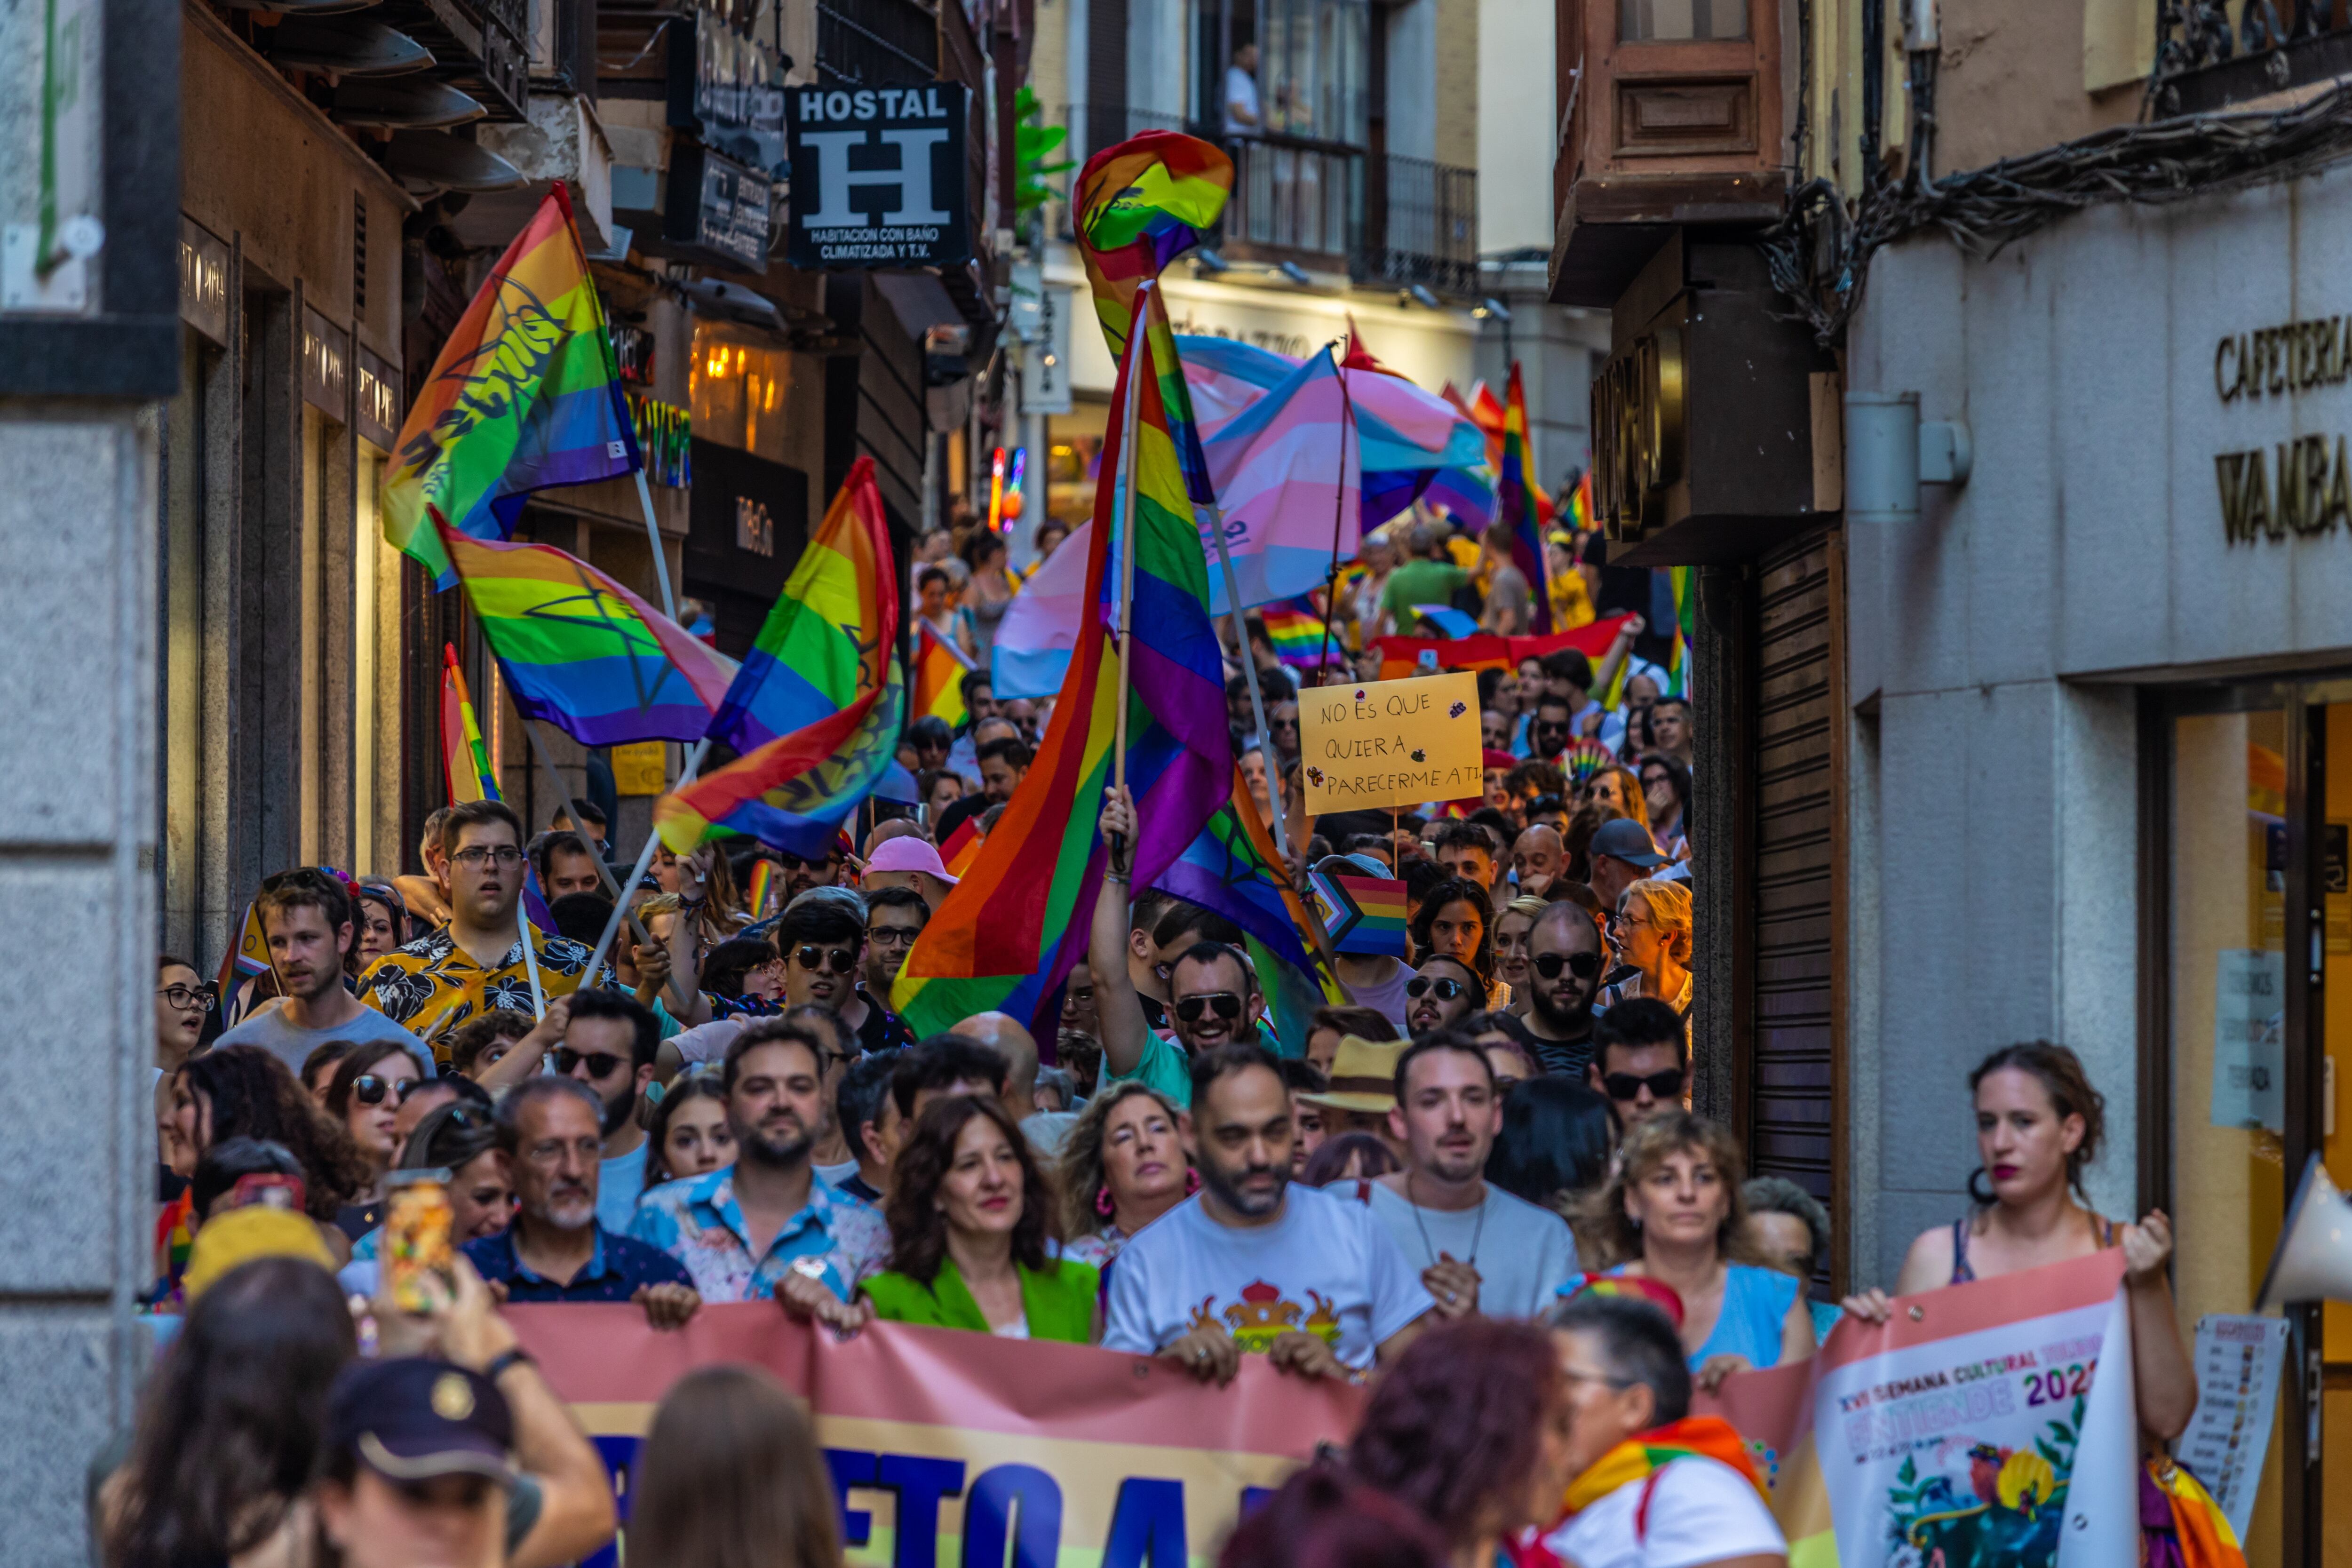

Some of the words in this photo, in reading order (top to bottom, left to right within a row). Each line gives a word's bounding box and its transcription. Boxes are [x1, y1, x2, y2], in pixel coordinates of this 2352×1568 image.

[800, 88, 947, 122] HOSTAL
[801, 129, 950, 228] H
[810, 228, 878, 243] HABITACION
[879, 228, 905, 242] CON
[906, 224, 939, 242] BAÑO
[820, 244, 895, 259] CLIMATIZADA
[897, 243, 906, 258] Y
[1321, 703, 1346, 724] NO
[1355, 701, 1377, 720] ES
[1387, 694, 1430, 716] QUE
[1328, 770, 1442, 795] PARECERME
[1446, 767, 1460, 785] A
[1873, 1369, 1949, 1402] SEMANA
[1953, 1351, 2038, 1385] CULTURAL
